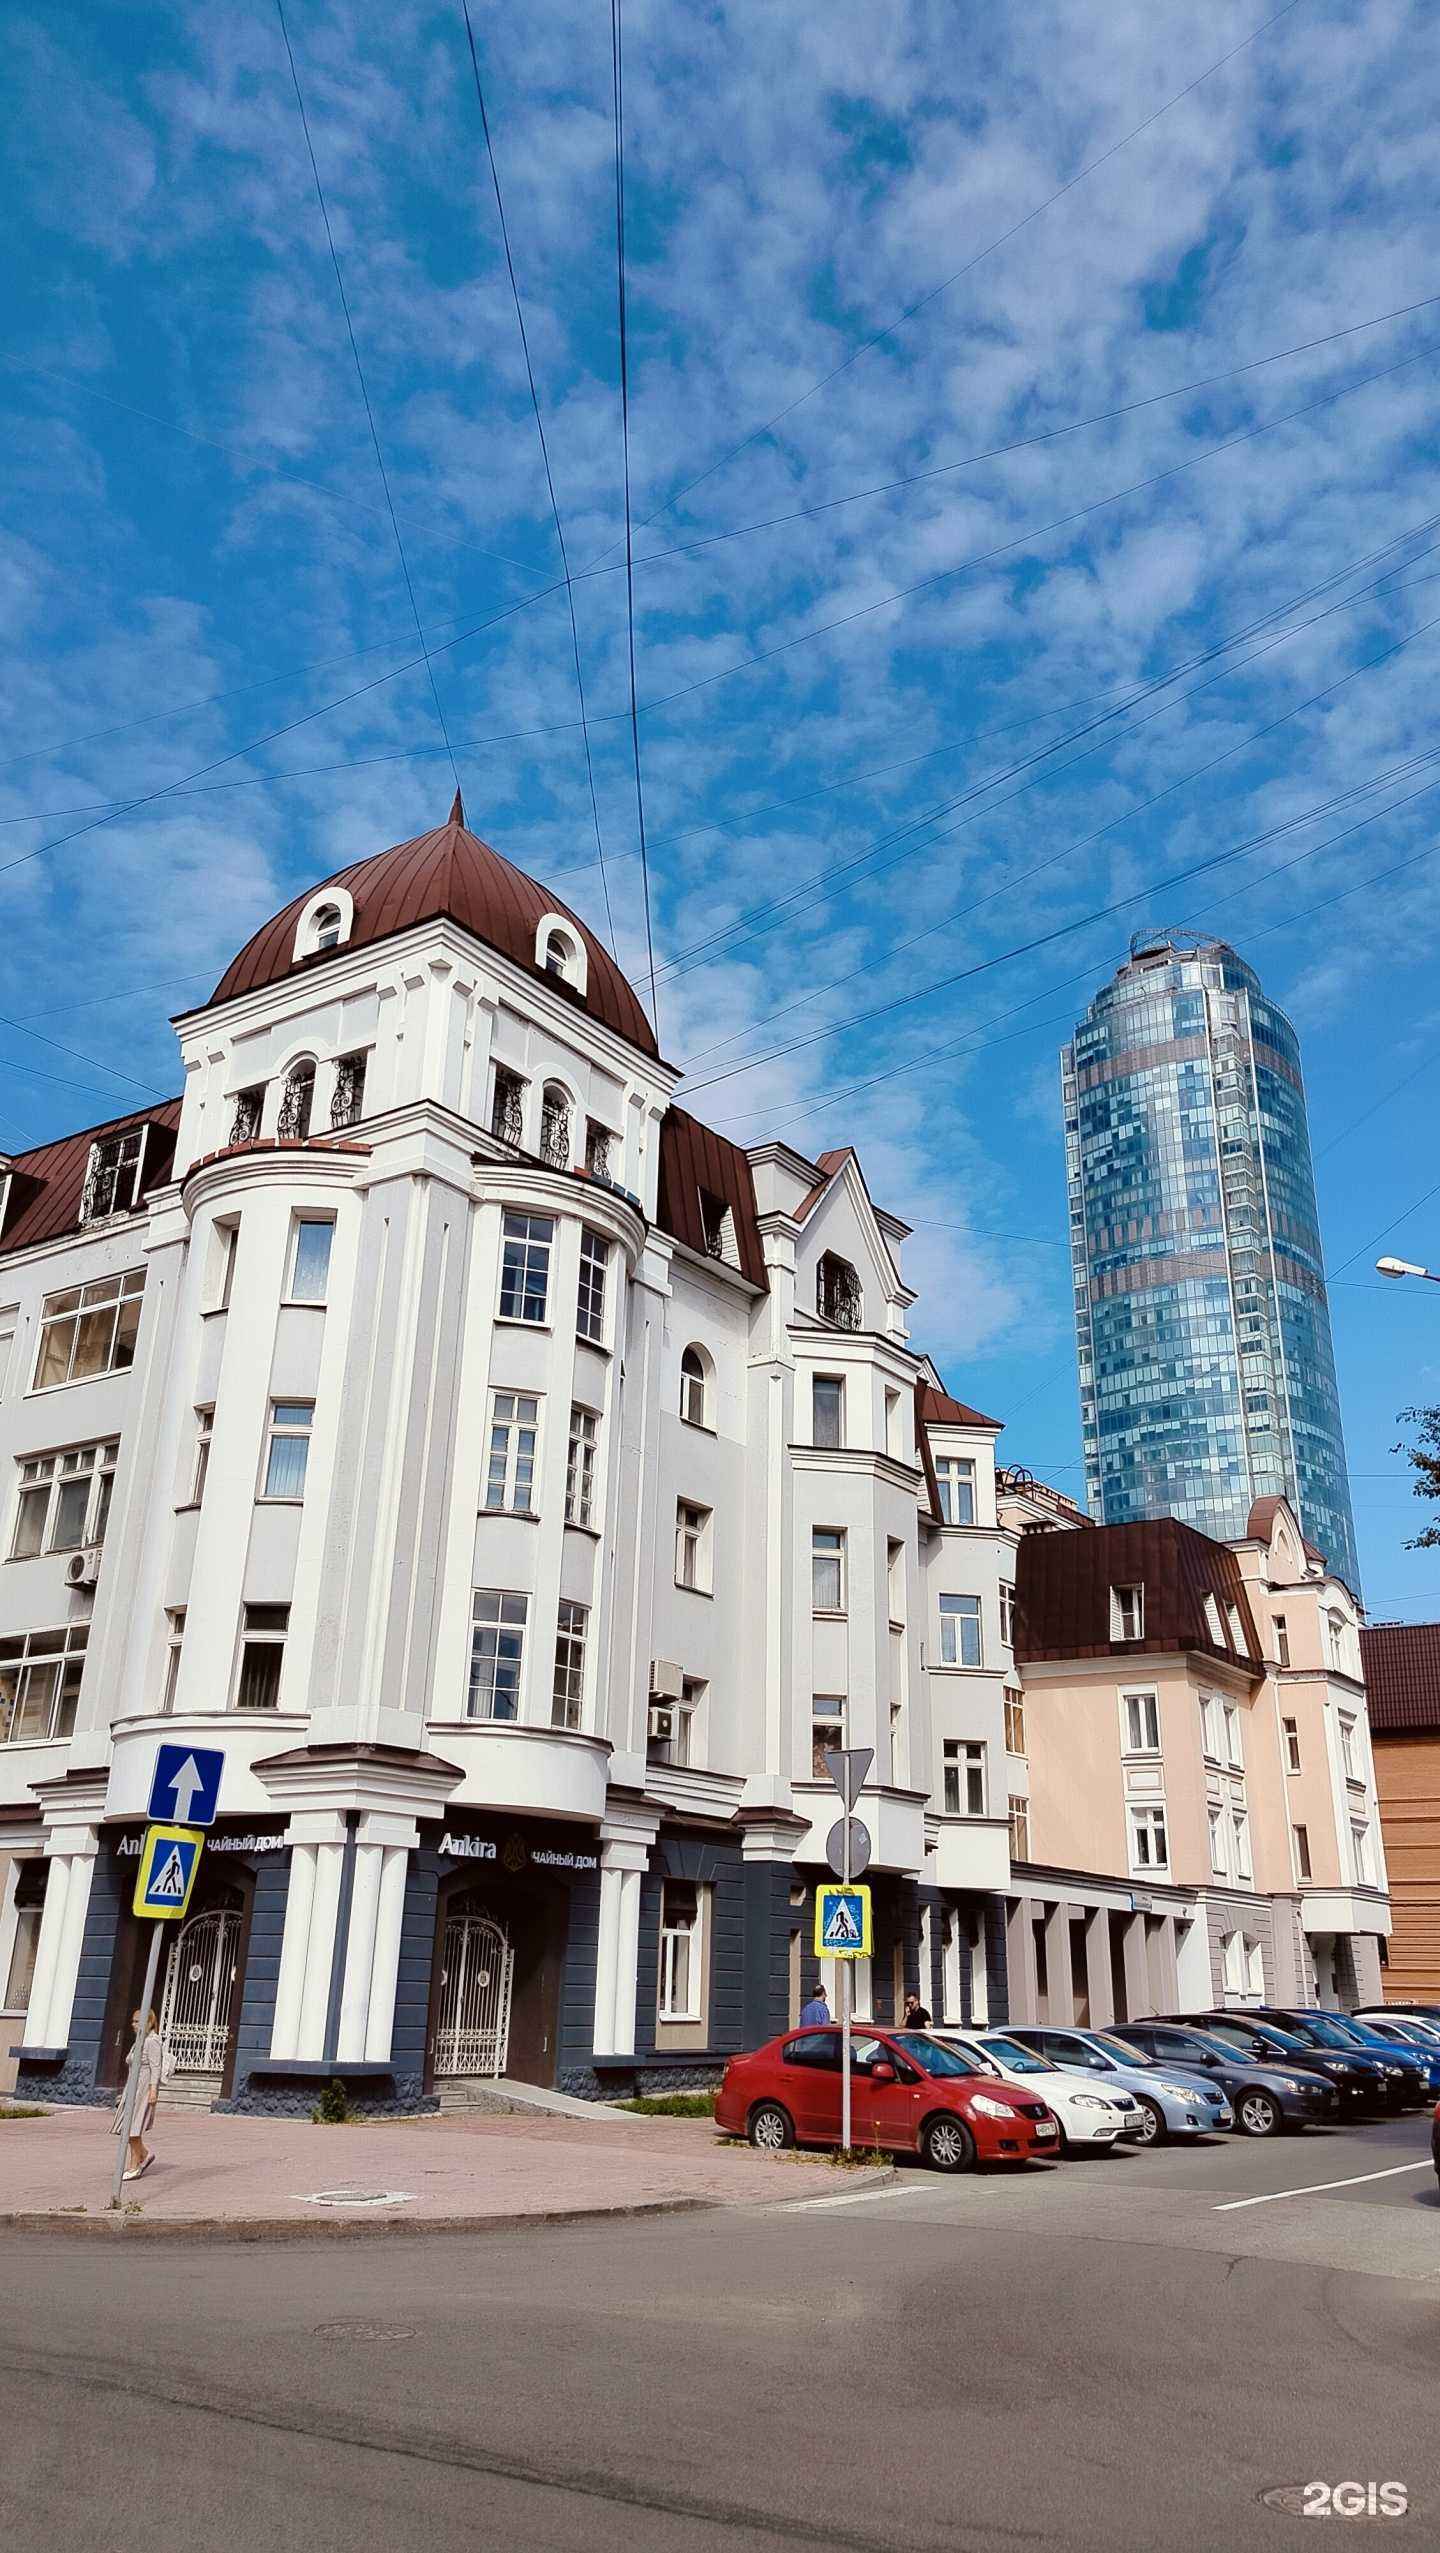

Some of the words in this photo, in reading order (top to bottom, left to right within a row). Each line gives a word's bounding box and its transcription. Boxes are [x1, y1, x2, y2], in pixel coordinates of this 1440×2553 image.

[207, 1835, 255, 1851] ЧАЙНЫЙ
[254, 1836, 284, 1852] ДОМ
[438, 1832, 497, 1859] Ankira
[532, 1850, 574, 1866] ЧАЙНЫЙ
[575, 1855, 597, 1869] ДОМ
